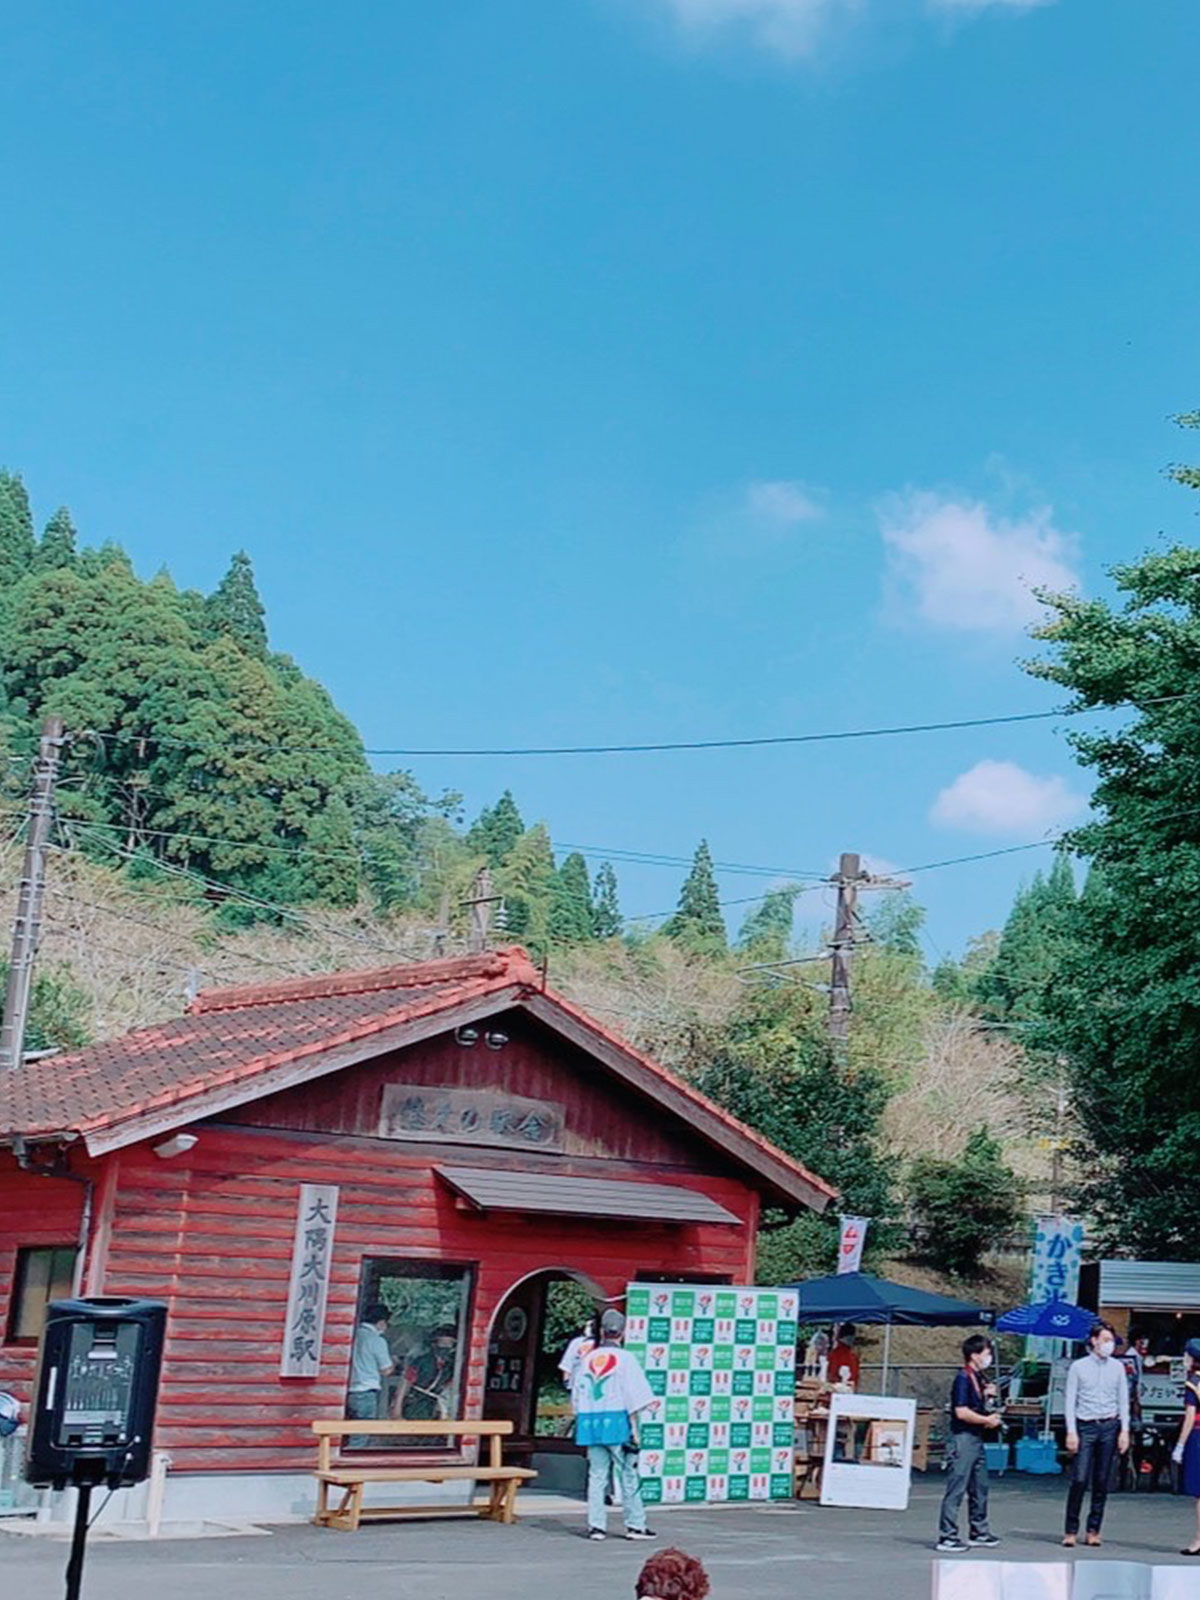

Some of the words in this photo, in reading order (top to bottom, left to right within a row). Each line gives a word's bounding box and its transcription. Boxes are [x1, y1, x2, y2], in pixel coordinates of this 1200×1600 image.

[289, 1198, 332, 1362] 大隅大川原駅
